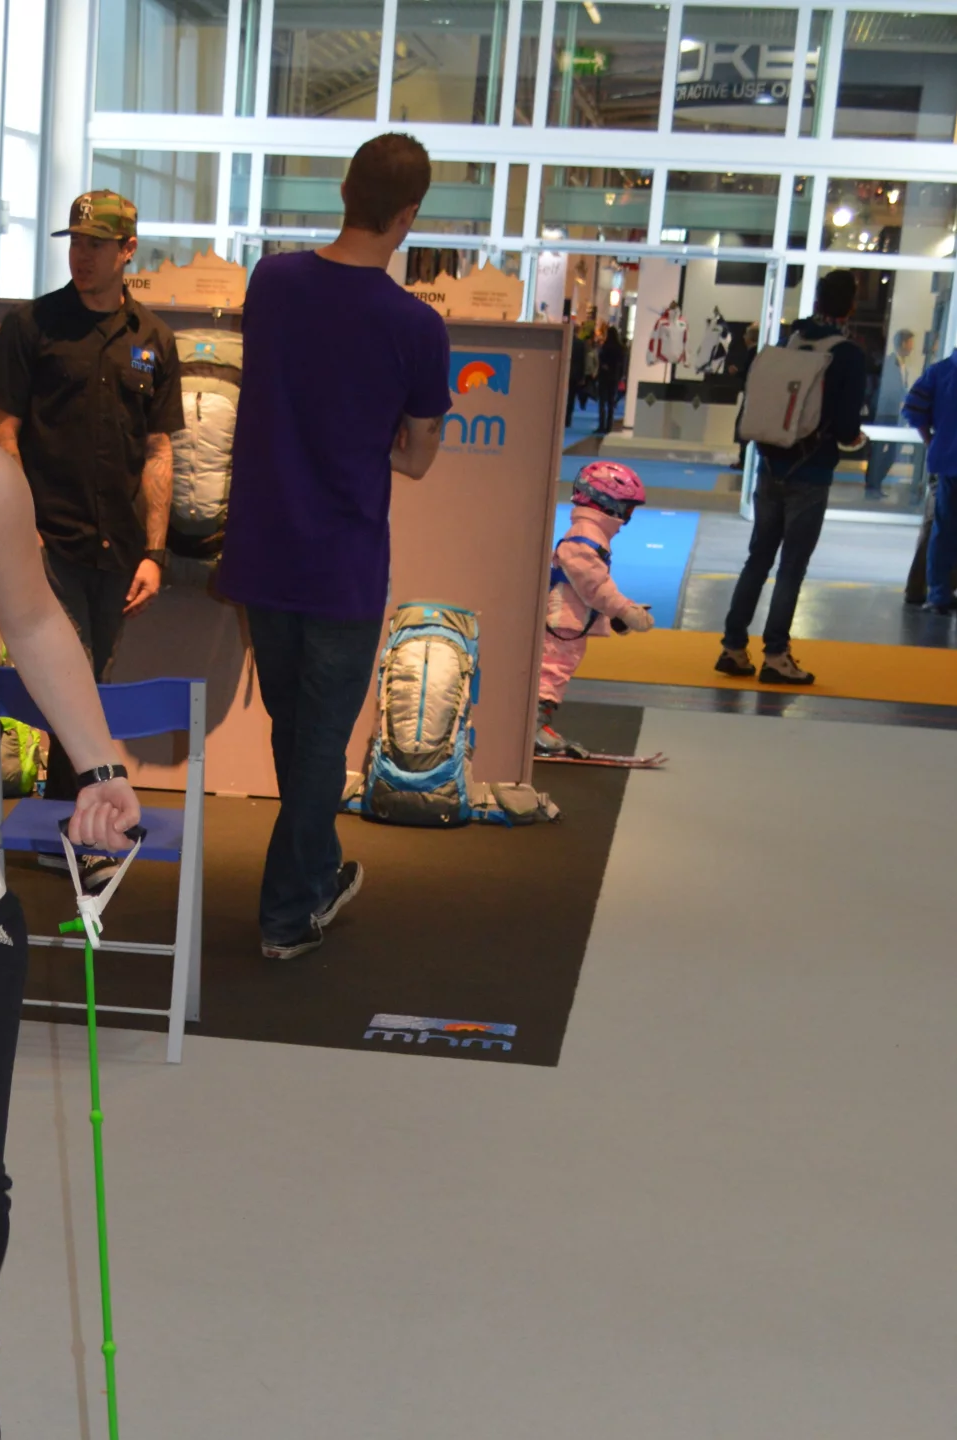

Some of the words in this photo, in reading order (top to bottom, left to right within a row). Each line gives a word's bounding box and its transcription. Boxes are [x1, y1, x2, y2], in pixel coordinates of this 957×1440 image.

[688, 83, 729, 99] ACTIVE
[733, 82, 767, 97] USE
[363, 1029, 512, 1051] mhm
